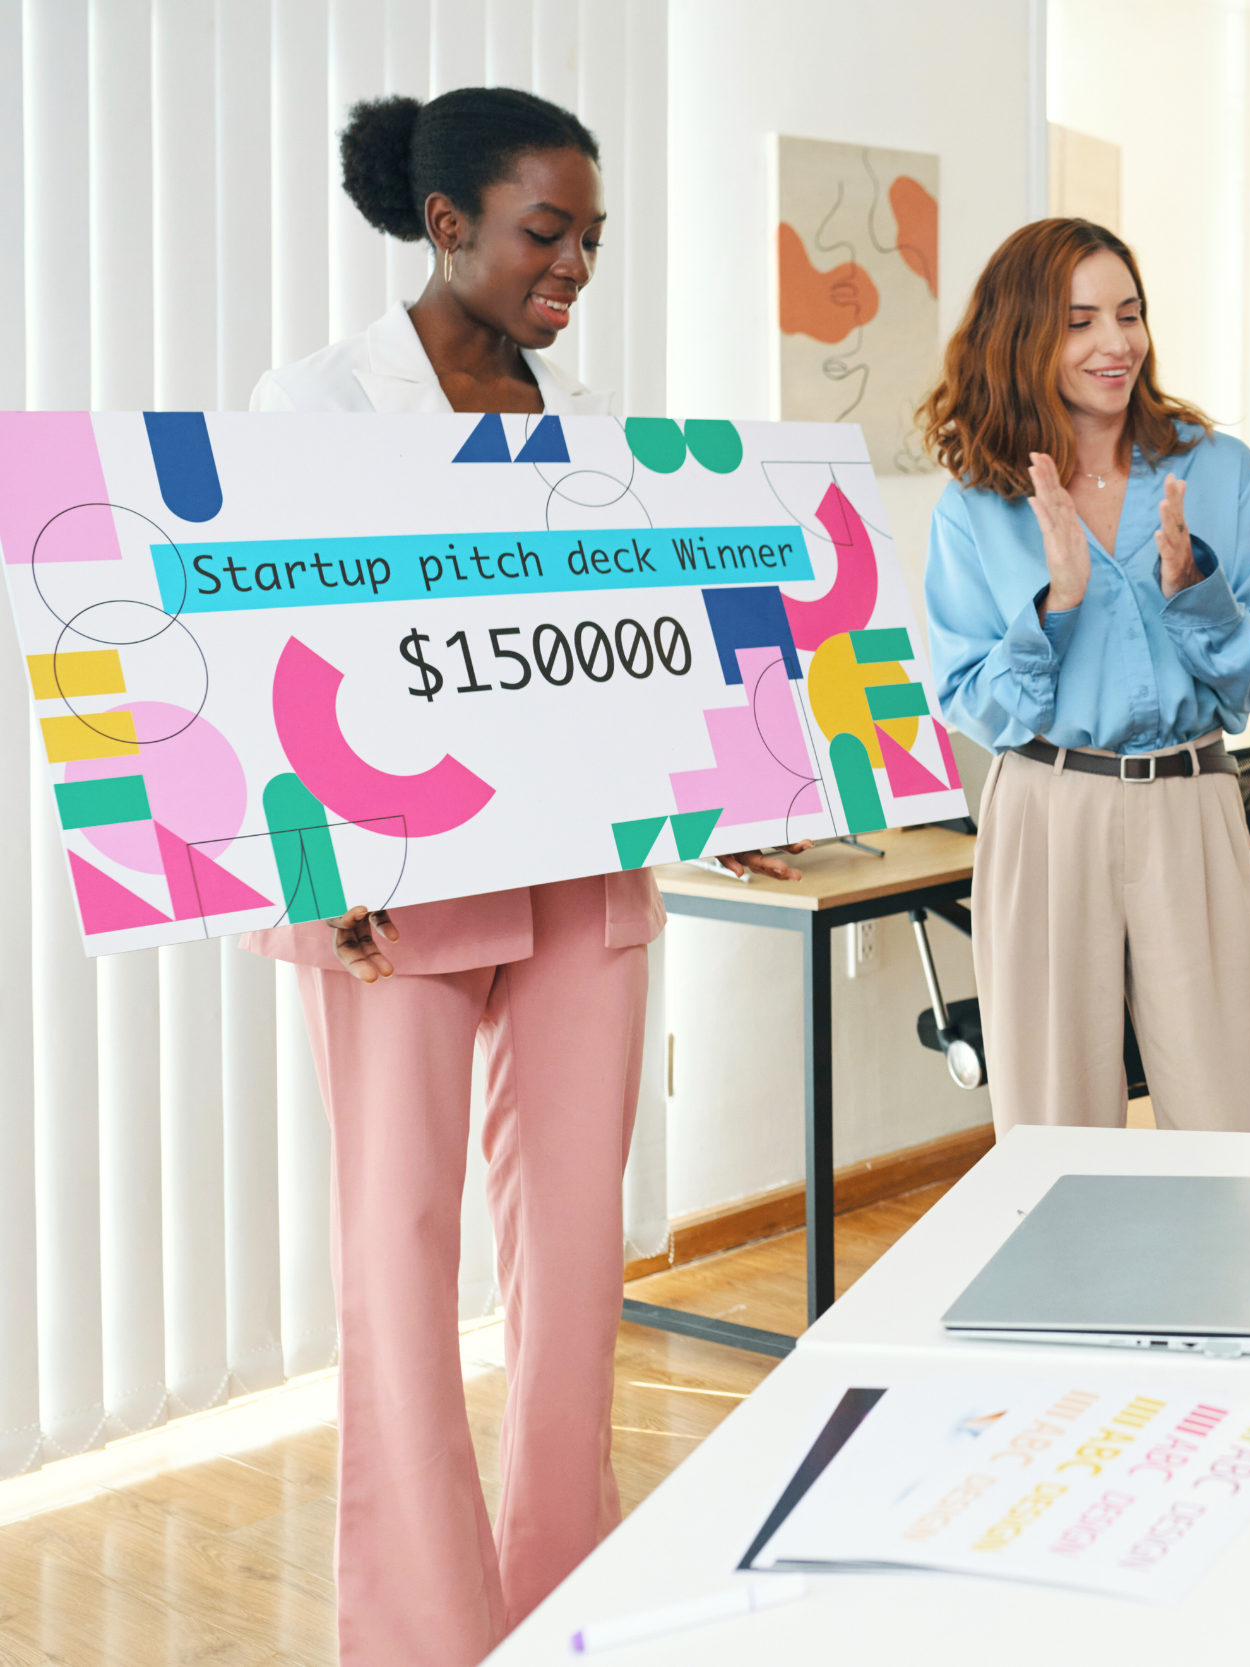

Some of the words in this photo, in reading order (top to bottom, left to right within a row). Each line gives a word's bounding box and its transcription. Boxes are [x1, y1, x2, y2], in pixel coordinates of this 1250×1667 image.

[192, 552, 391, 595] Startup
[418, 540, 544, 592] pitch
[567, 538, 657, 576] deck
[671, 537, 794, 571] Winner
[398, 616, 693, 704] $150000
[989, 1419, 1067, 1468] ABC
[1056, 1427, 1136, 1478] ABC
[1128, 1433, 1199, 1484] ABC
[900, 1472, 997, 1543] DESIGN
[968, 1481, 1069, 1554] DESIGN
[1048, 1489, 1136, 1559] DESIGN
[1117, 1499, 1206, 1573] DESIGN
